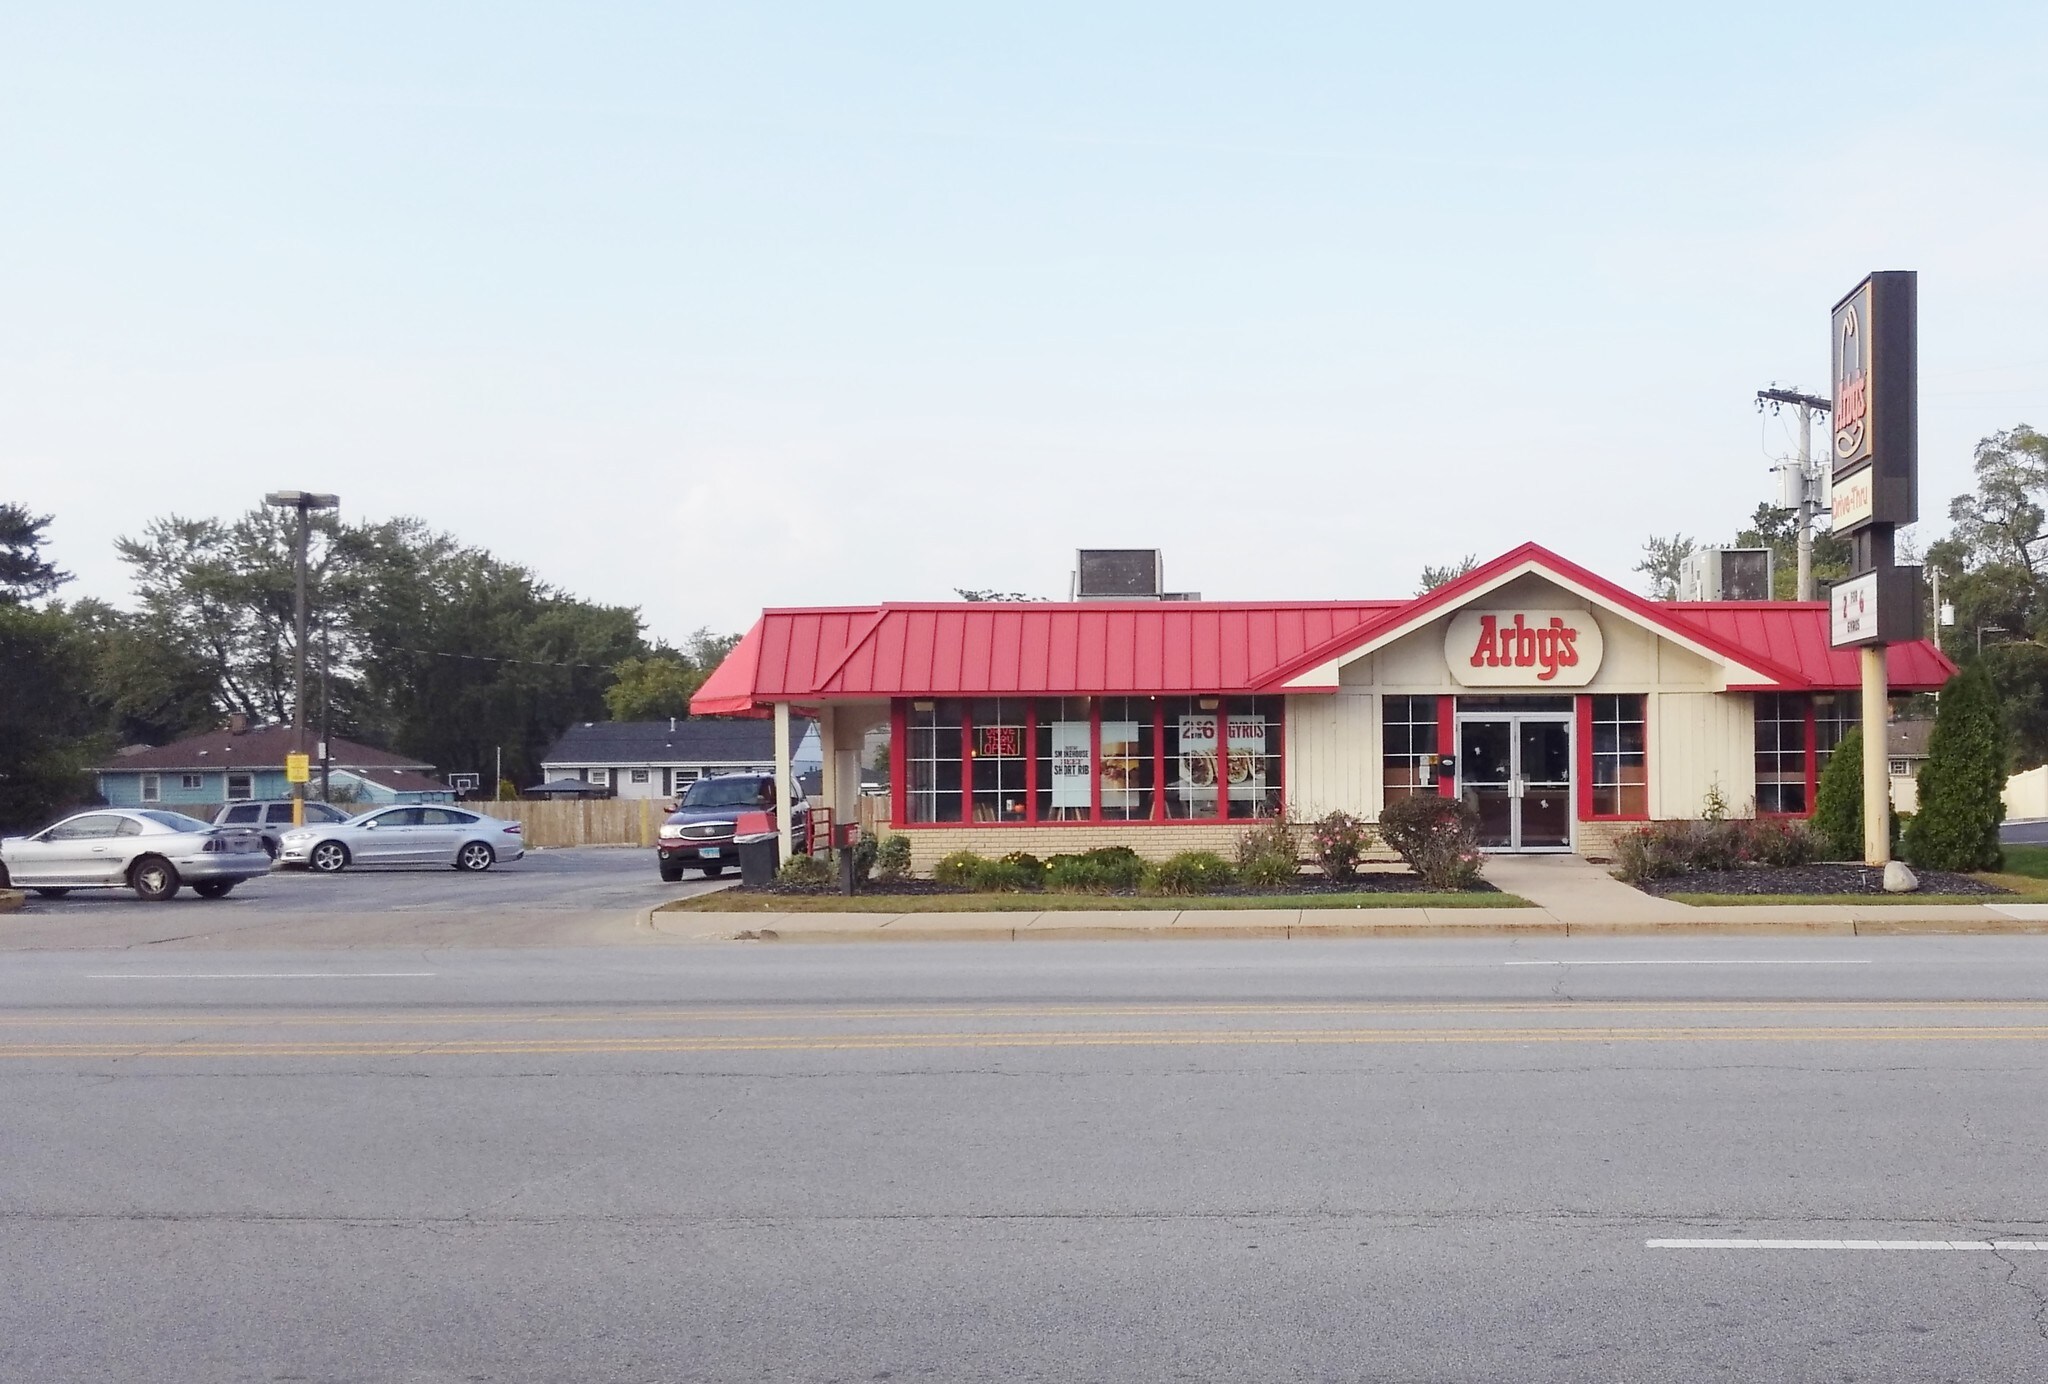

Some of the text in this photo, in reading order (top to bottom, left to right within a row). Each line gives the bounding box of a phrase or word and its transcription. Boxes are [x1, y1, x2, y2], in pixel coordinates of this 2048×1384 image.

[1834, 368, 1867, 436] Arby's
[1470, 614, 1579, 681] Arby's
[1077, 764, 1090, 775] RIB
